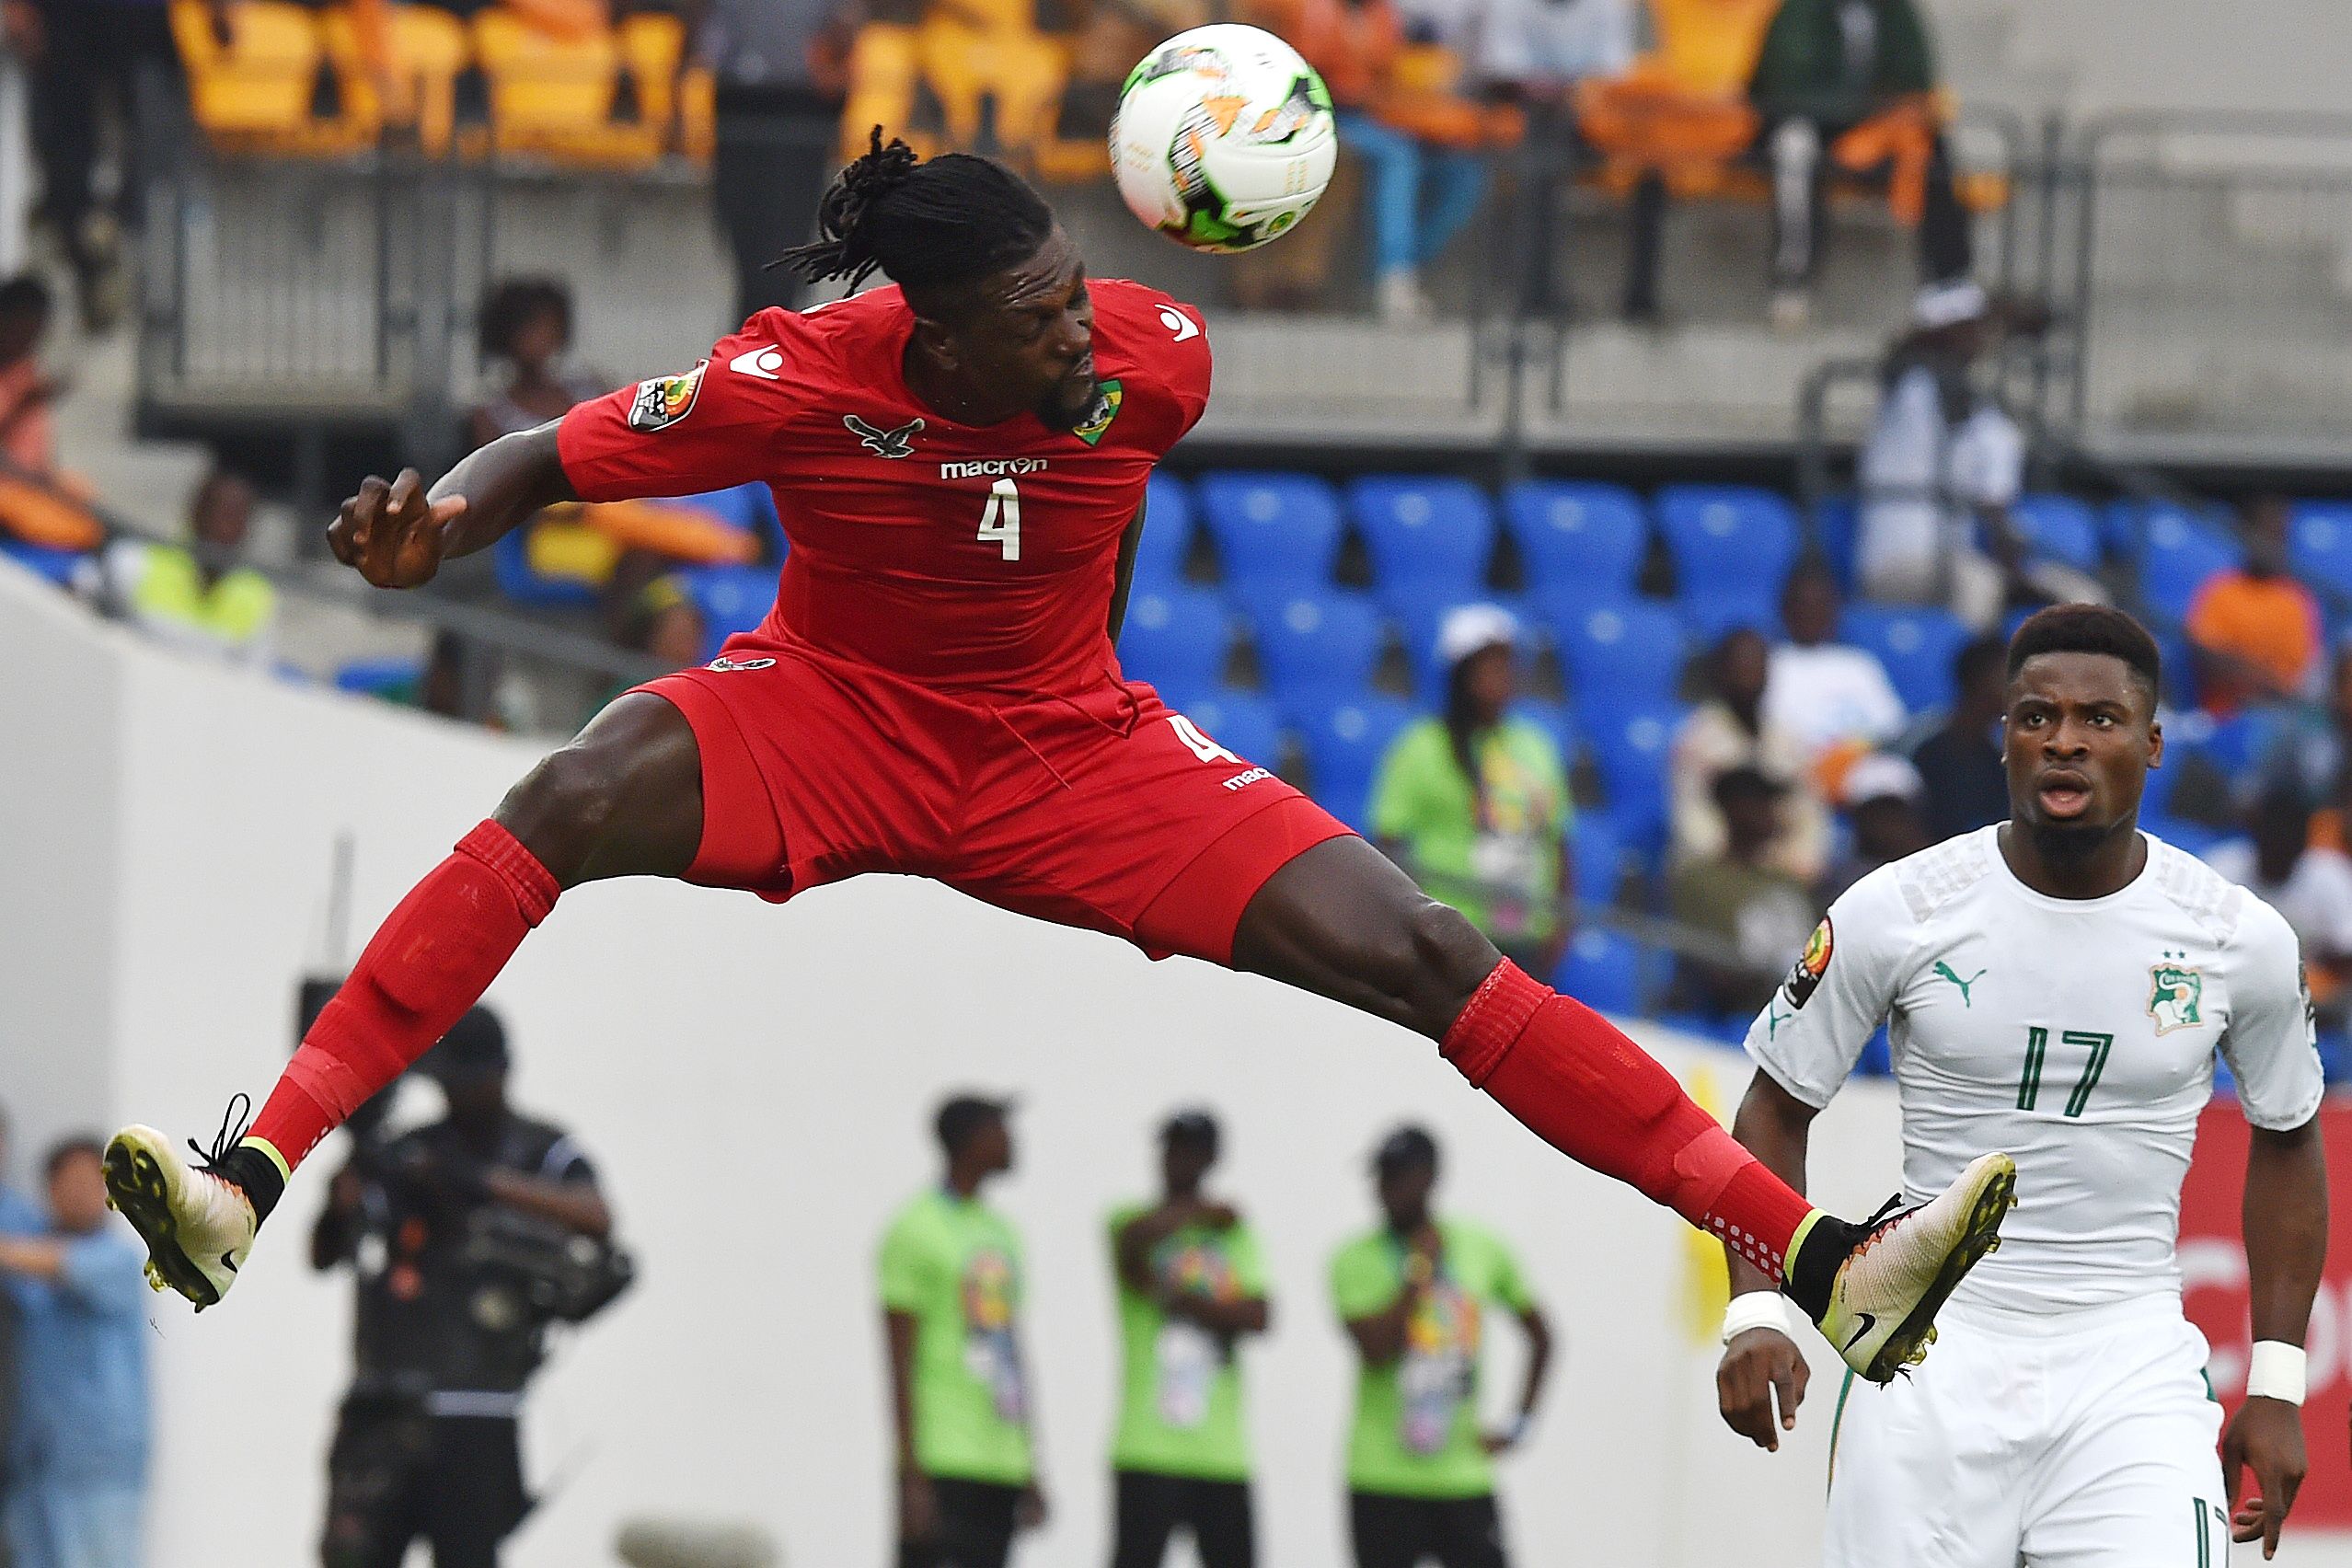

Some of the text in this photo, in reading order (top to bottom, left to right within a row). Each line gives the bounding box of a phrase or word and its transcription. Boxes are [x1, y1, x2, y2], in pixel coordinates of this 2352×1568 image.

[940, 458, 1048, 479] macron
[976, 478, 1020, 561] 4
[1165, 714, 1243, 764] 4
[1222, 766, 1274, 791] mac
[2016, 1026, 2115, 1118] 17
